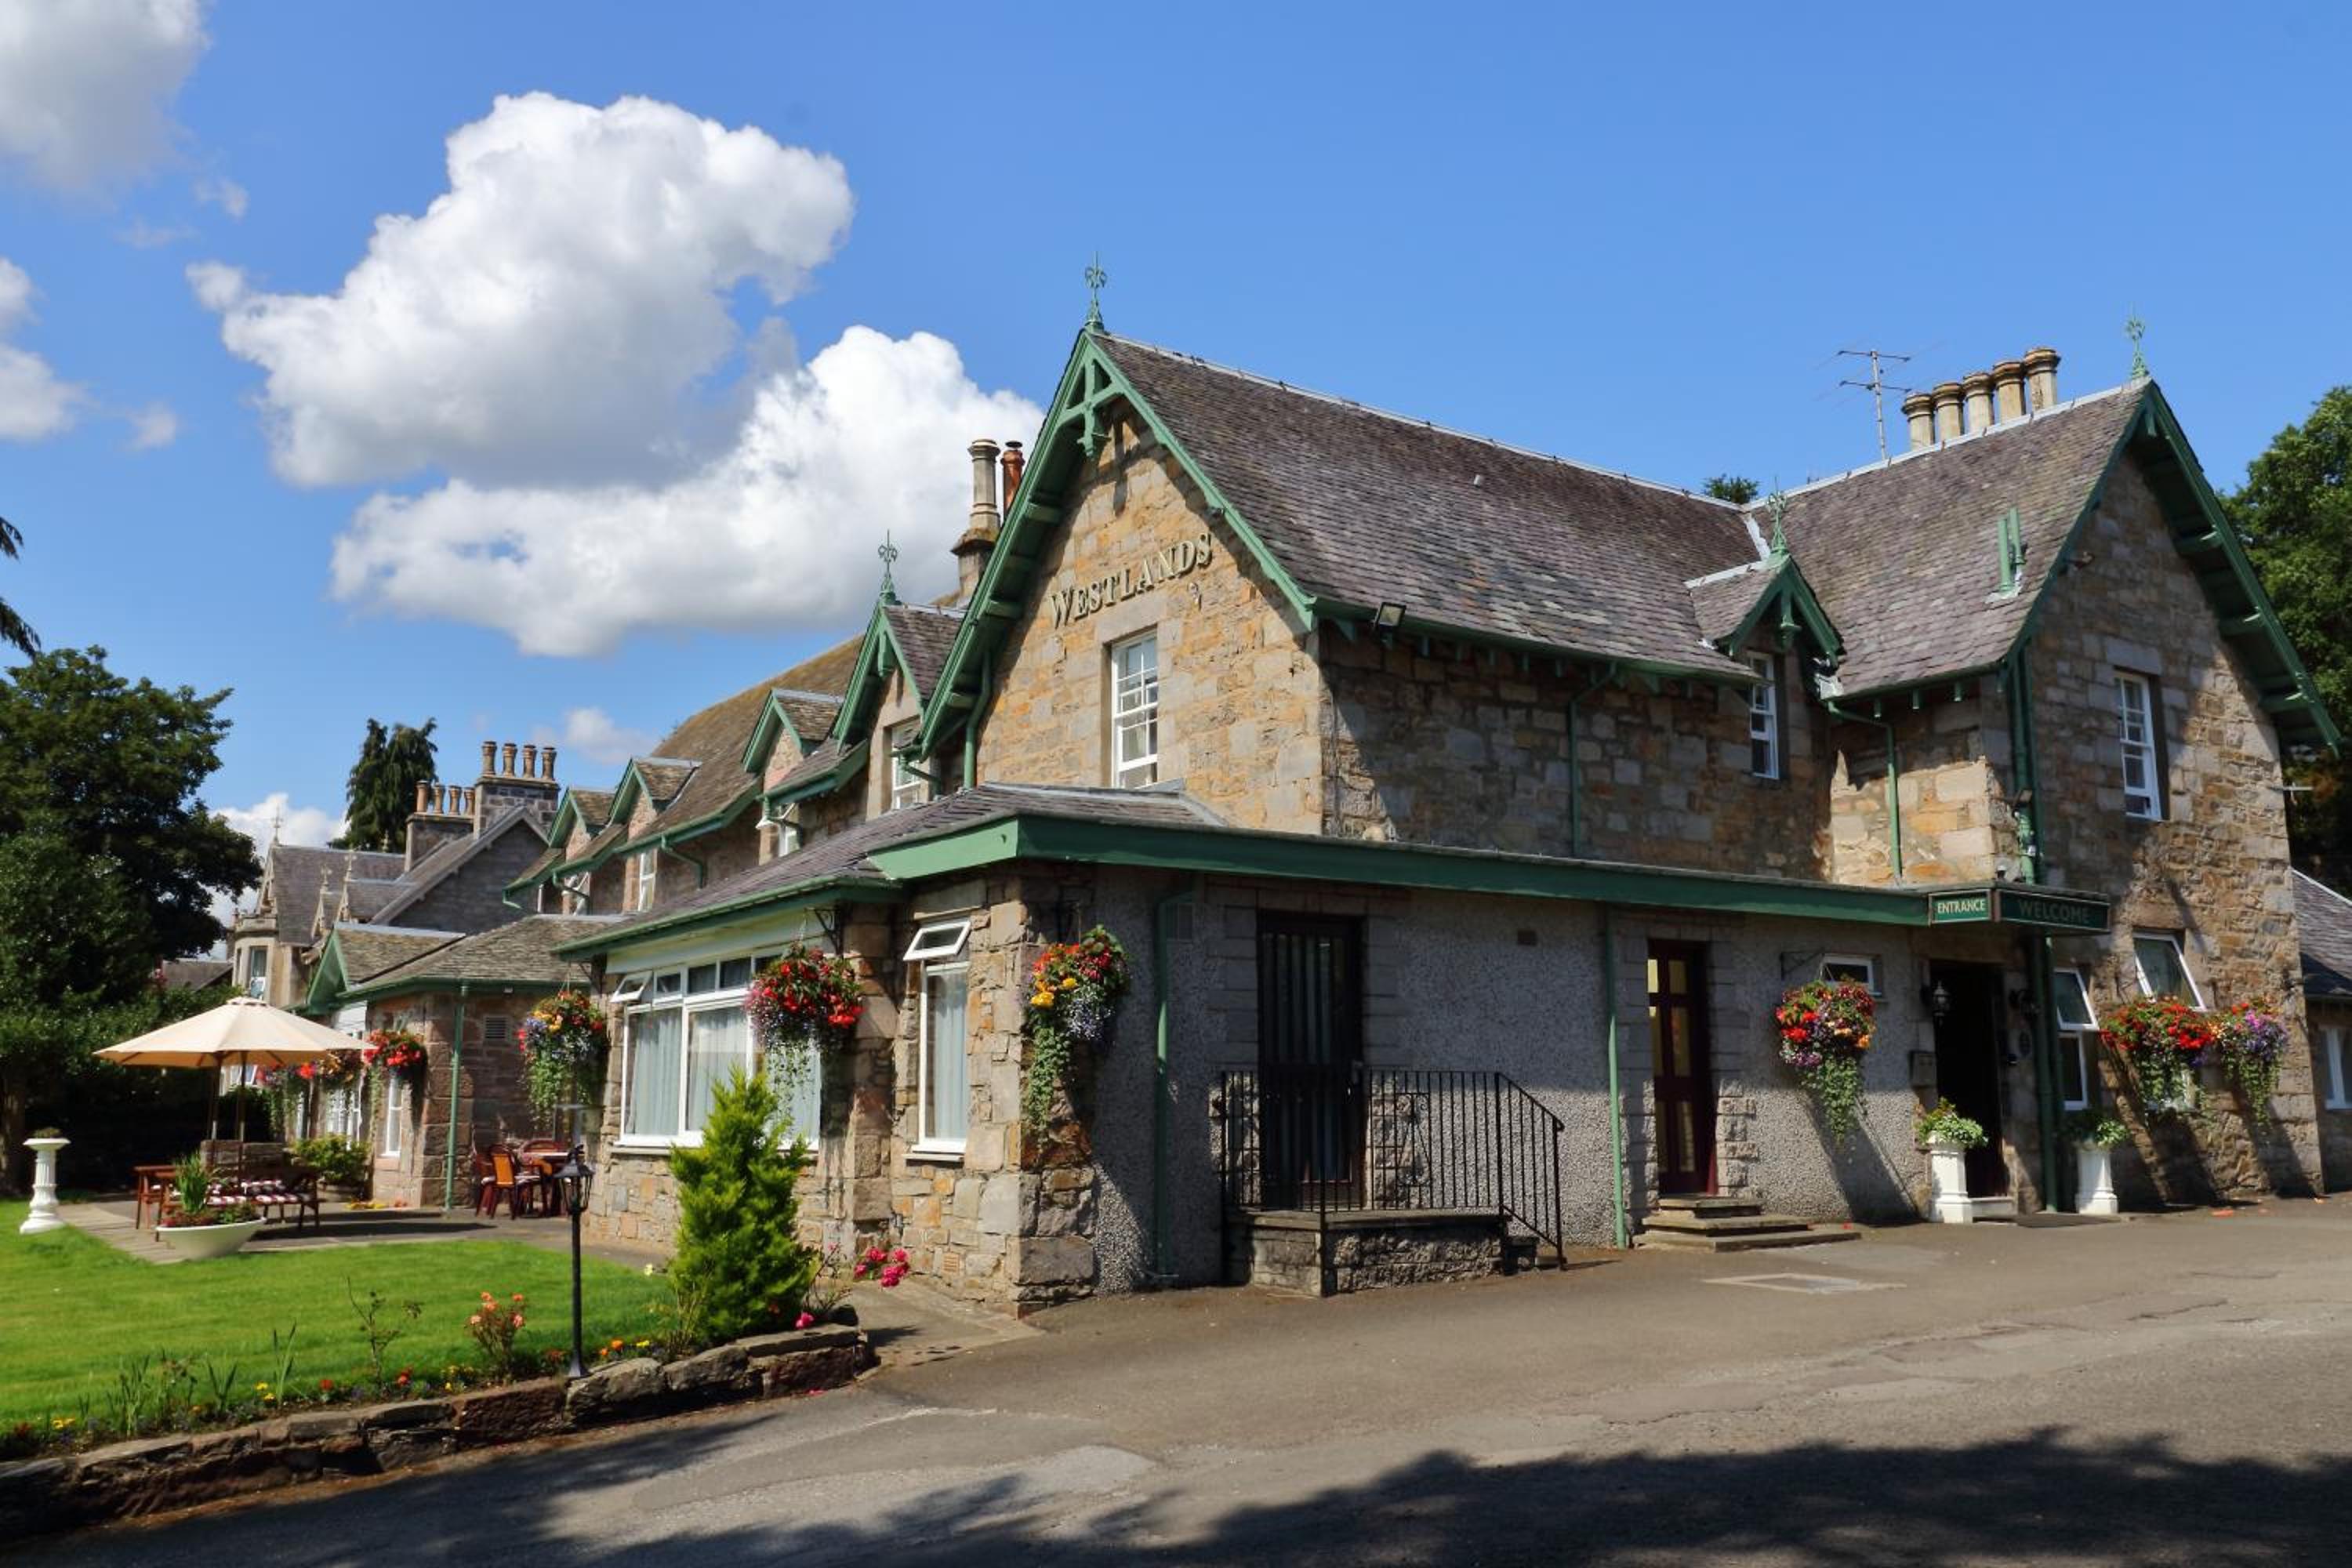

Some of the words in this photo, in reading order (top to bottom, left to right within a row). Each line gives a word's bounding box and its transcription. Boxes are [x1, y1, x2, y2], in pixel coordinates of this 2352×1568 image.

[1050, 532, 1213, 628] WESTLANDS
[1937, 899, 1986, 914] ENTRANCE
[2018, 899, 2090, 924] WELCOME
